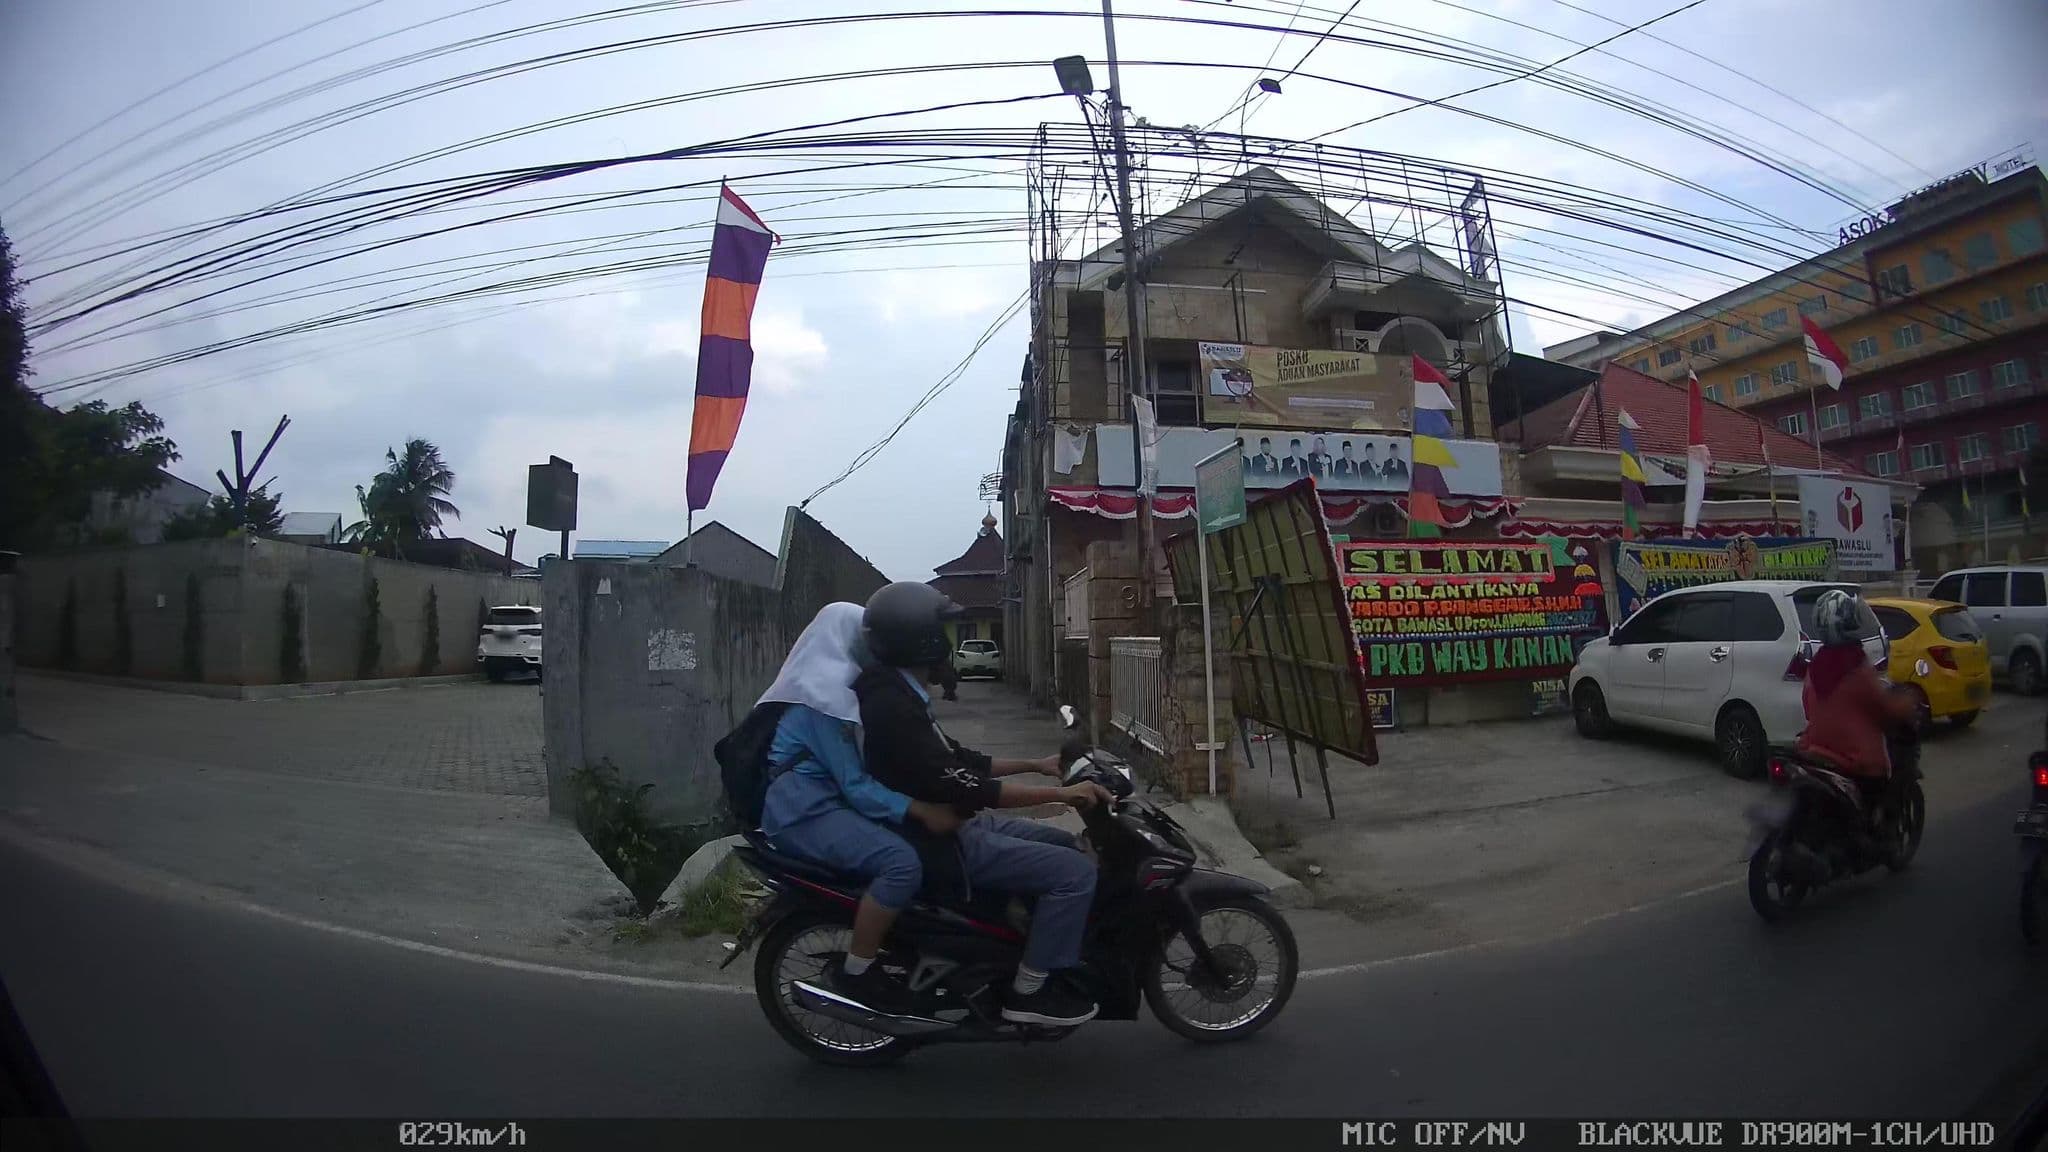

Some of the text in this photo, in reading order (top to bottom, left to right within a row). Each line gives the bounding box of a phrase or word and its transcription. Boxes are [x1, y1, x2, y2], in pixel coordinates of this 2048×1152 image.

[1277, 366, 1305, 382] ADUAN
[1306, 358, 1360, 378] MASYARAKAT
[1838, 539, 1872, 551] AWASLU
[1350, 549, 1546, 573] SELAMAT
[1389, 583, 1540, 600] DILANTIKNYA
[1431, 640, 1488, 673] WAY
[1493, 634, 1574, 669] KANAN
[1366, 693, 1389, 706] SA
